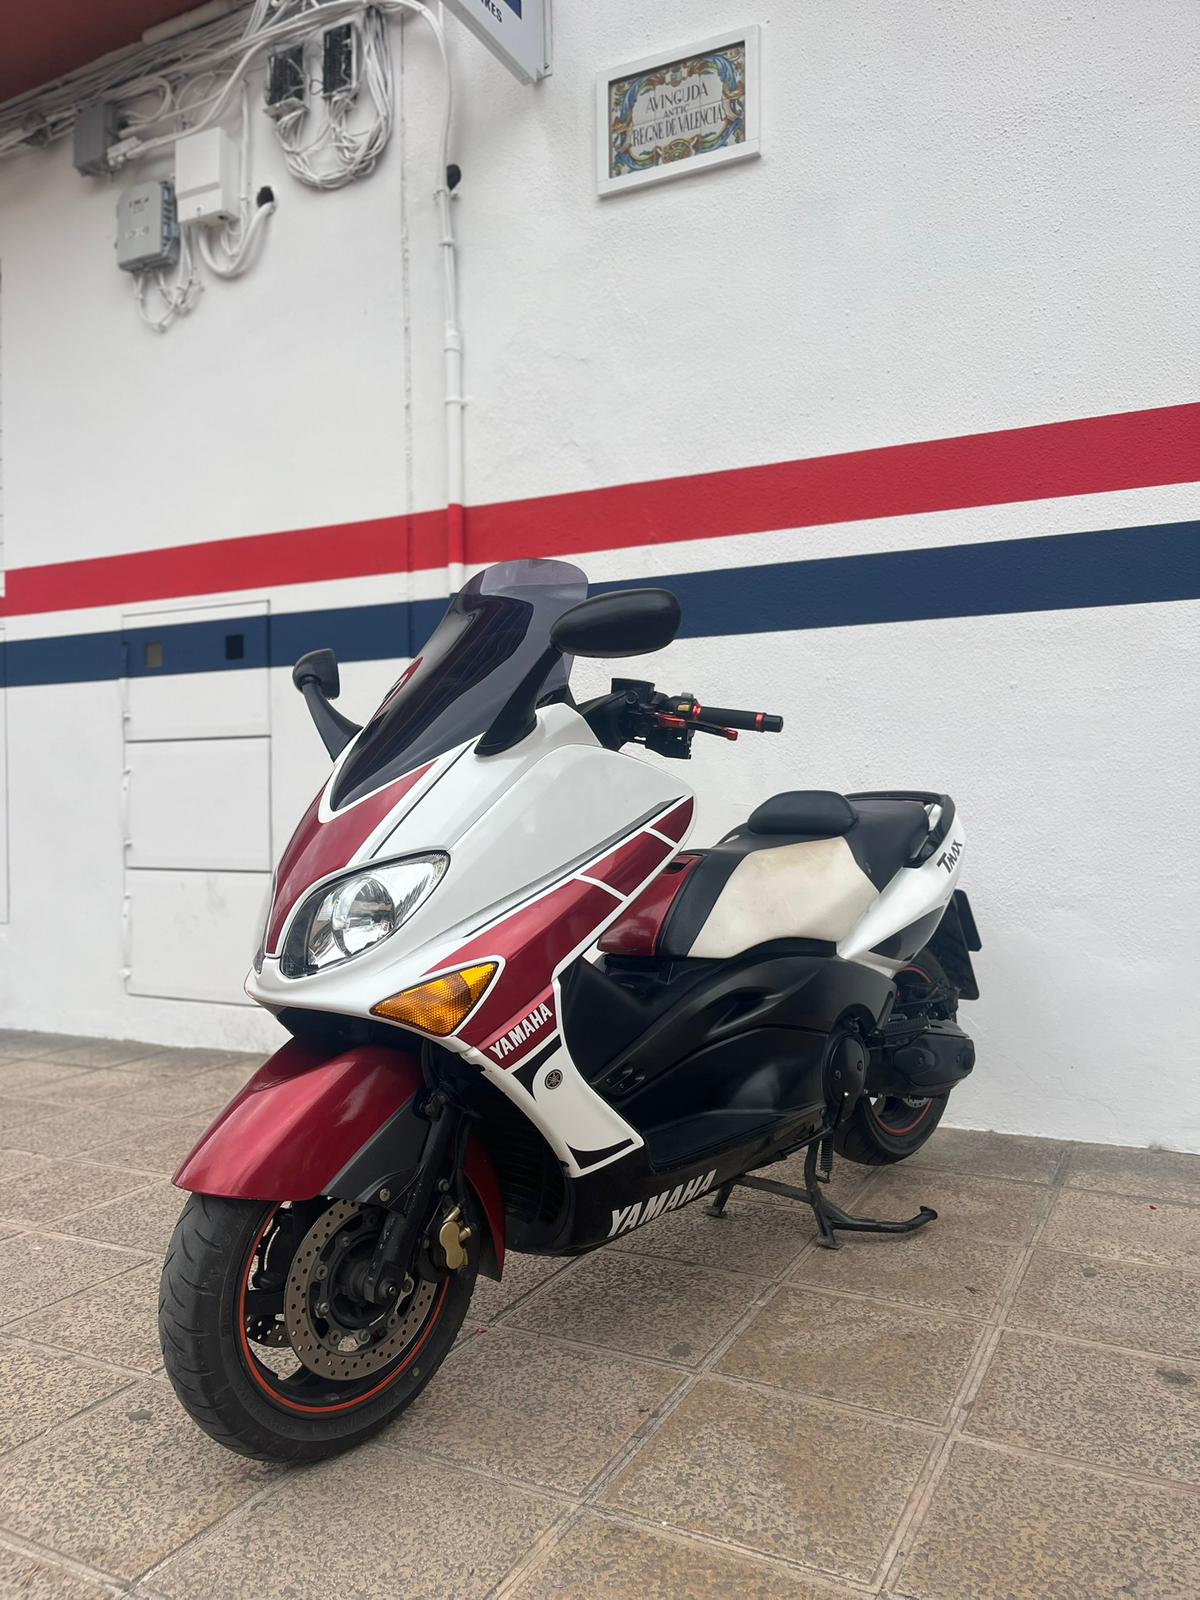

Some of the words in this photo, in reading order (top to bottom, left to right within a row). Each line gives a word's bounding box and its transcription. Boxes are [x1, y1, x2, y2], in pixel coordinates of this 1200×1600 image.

[646, 81, 709, 113] AVINGUDA
[663, 103, 689, 118] ANTIC
[632, 121, 664, 147] REGNE
[665, 118, 678, 138] DE
[489, 1003, 553, 1060] YAMAHA
[607, 1168, 717, 1238] YAMAHA
